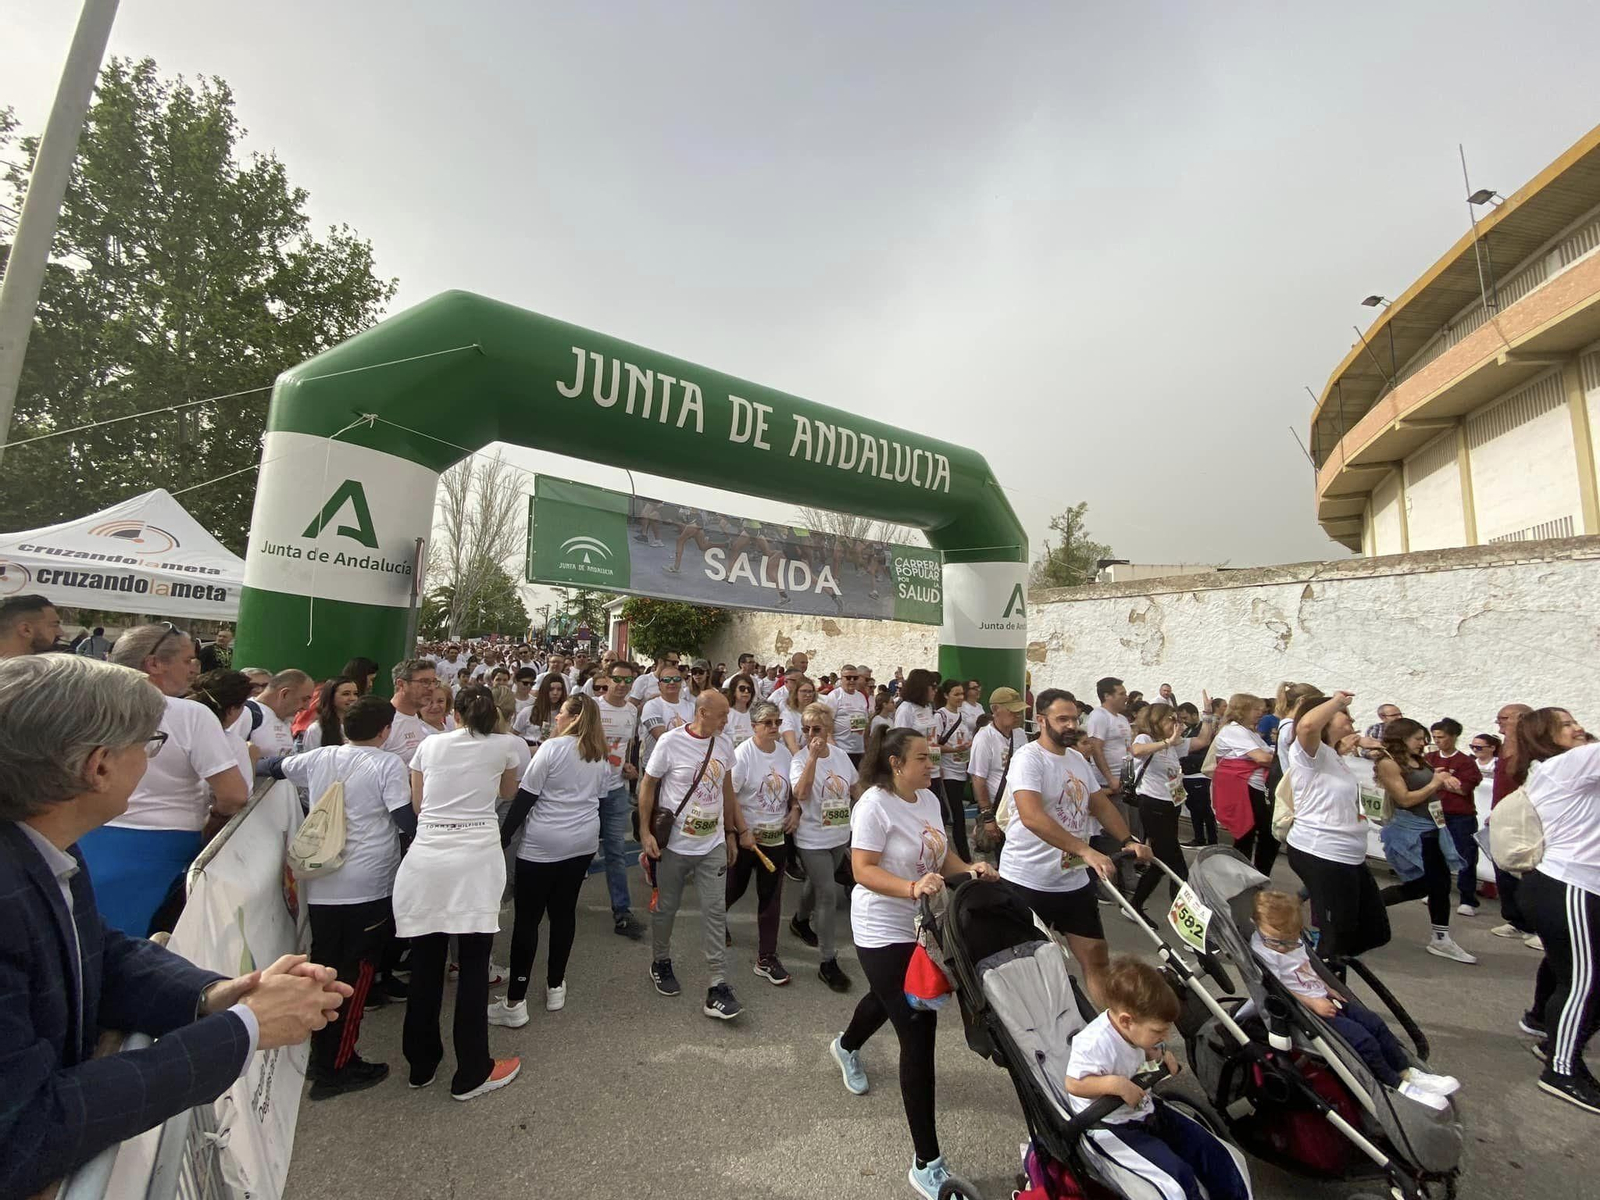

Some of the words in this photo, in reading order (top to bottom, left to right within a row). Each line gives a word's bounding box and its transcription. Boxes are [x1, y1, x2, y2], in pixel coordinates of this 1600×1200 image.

[556, 346, 704, 433] JUNTA
[729, 394, 773, 451] DE
[789, 413, 951, 494] ANDALUCIA
[18, 543, 221, 575] cruzandolameta
[261, 540, 301, 559] Junta
[307, 547, 329, 563] de
[333, 551, 412, 575] Andalucía
[559, 562, 576, 570] JUNTA
[895, 557, 940, 573] CARRERA
[704, 547, 842, 596] SALIDA
[895, 566, 940, 582] POPULAR
[36, 567, 227, 602] cruzandolameta
[898, 583, 941, 604] SALUD
[979, 621, 1004, 630] Junta
[1006, 621, 1015, 630] de
[828, 810, 849, 819] 5802
